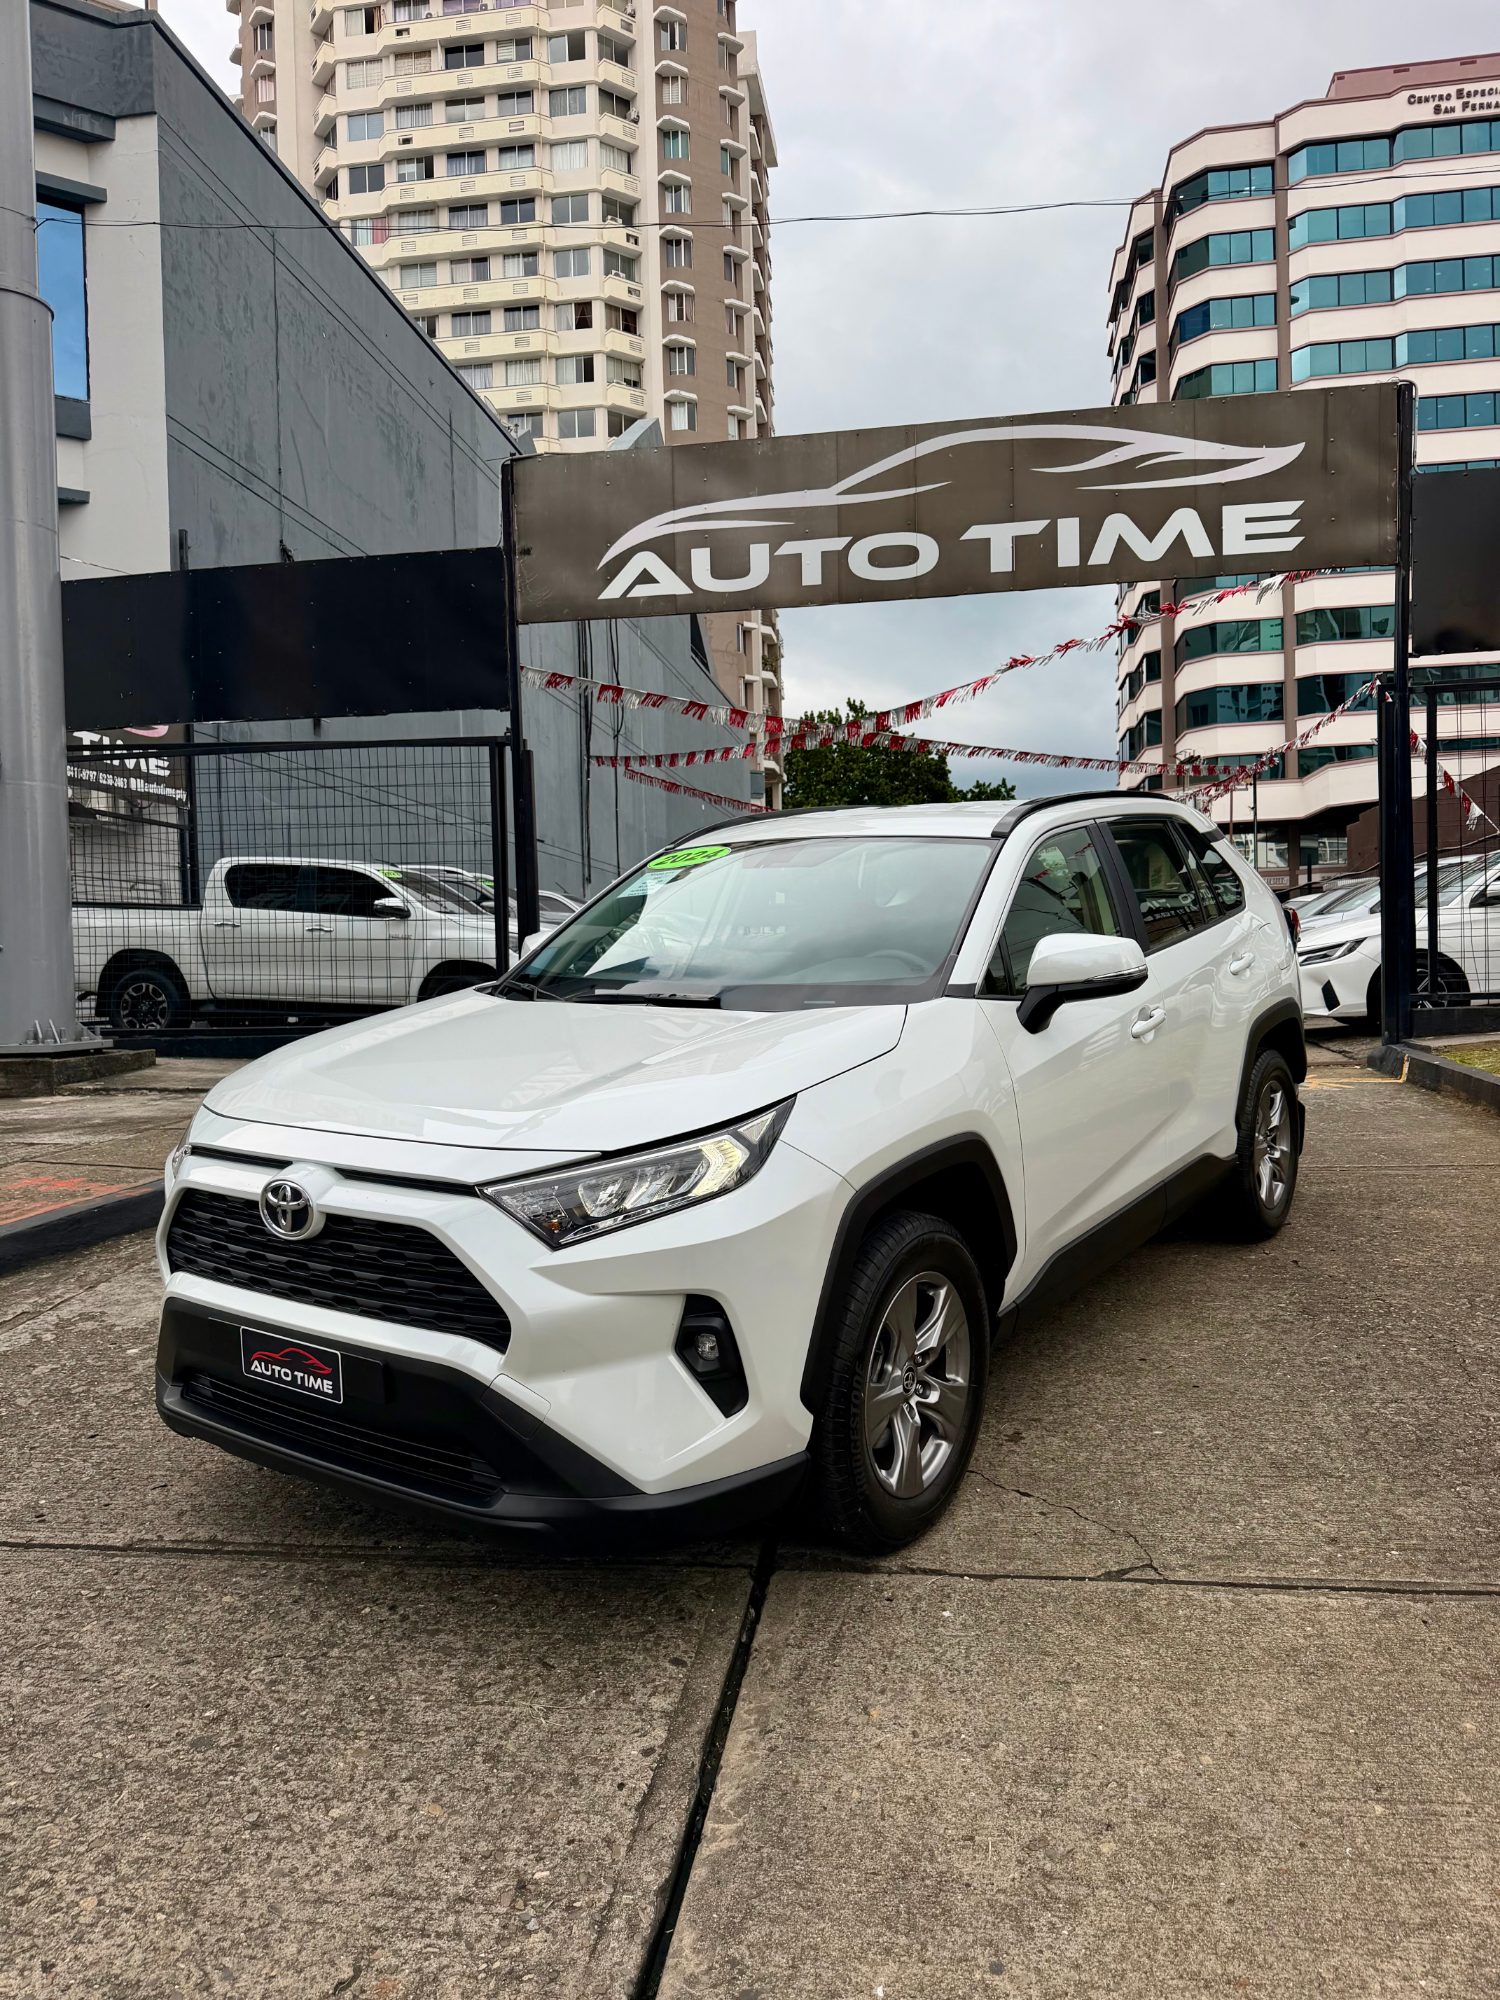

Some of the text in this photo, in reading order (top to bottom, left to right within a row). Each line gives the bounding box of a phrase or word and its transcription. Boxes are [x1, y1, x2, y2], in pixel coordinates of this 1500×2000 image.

[1407, 87, 1500, 105] CENTRO ESPECI
[1433, 103, 1456, 115] SAN
[598, 500, 1305, 600] AUTO TIME
[250, 1359, 334, 1395] AUTO TIME
